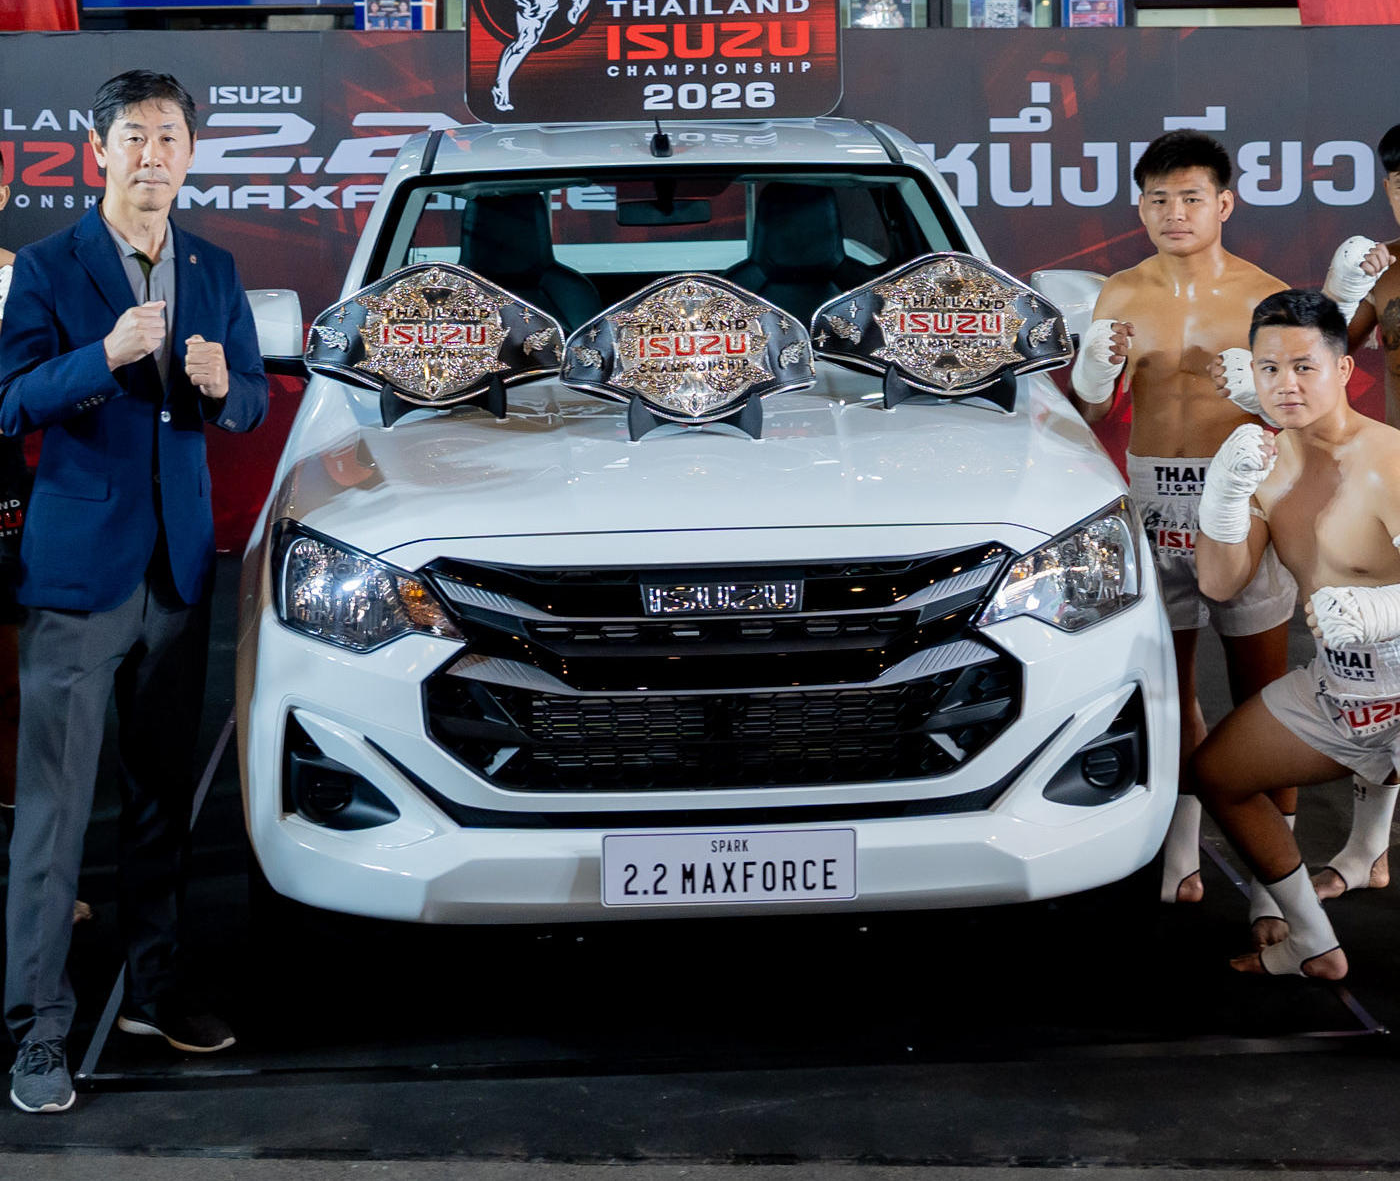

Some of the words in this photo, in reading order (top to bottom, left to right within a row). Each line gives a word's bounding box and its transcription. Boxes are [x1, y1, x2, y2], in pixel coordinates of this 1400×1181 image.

[607, 21, 810, 60] ISUZU
[607, 62, 811, 77] CHAMPIONSHIP
[209, 86, 302, 105] ISUZU
[643, 81, 776, 110] 2026
[899, 313, 1002, 334] ISUZU
[382, 325, 487, 346] ISUZU
[638, 334, 747, 359] ISUZU
[1154, 466, 1205, 482] THAI
[648, 583, 796, 613] ISUZU
[1324, 647, 1372, 669] THAI
[710, 839, 749, 854] SPARK
[623, 862, 668, 896] 2.2
[680, 858, 838, 895] MAXFORCE
